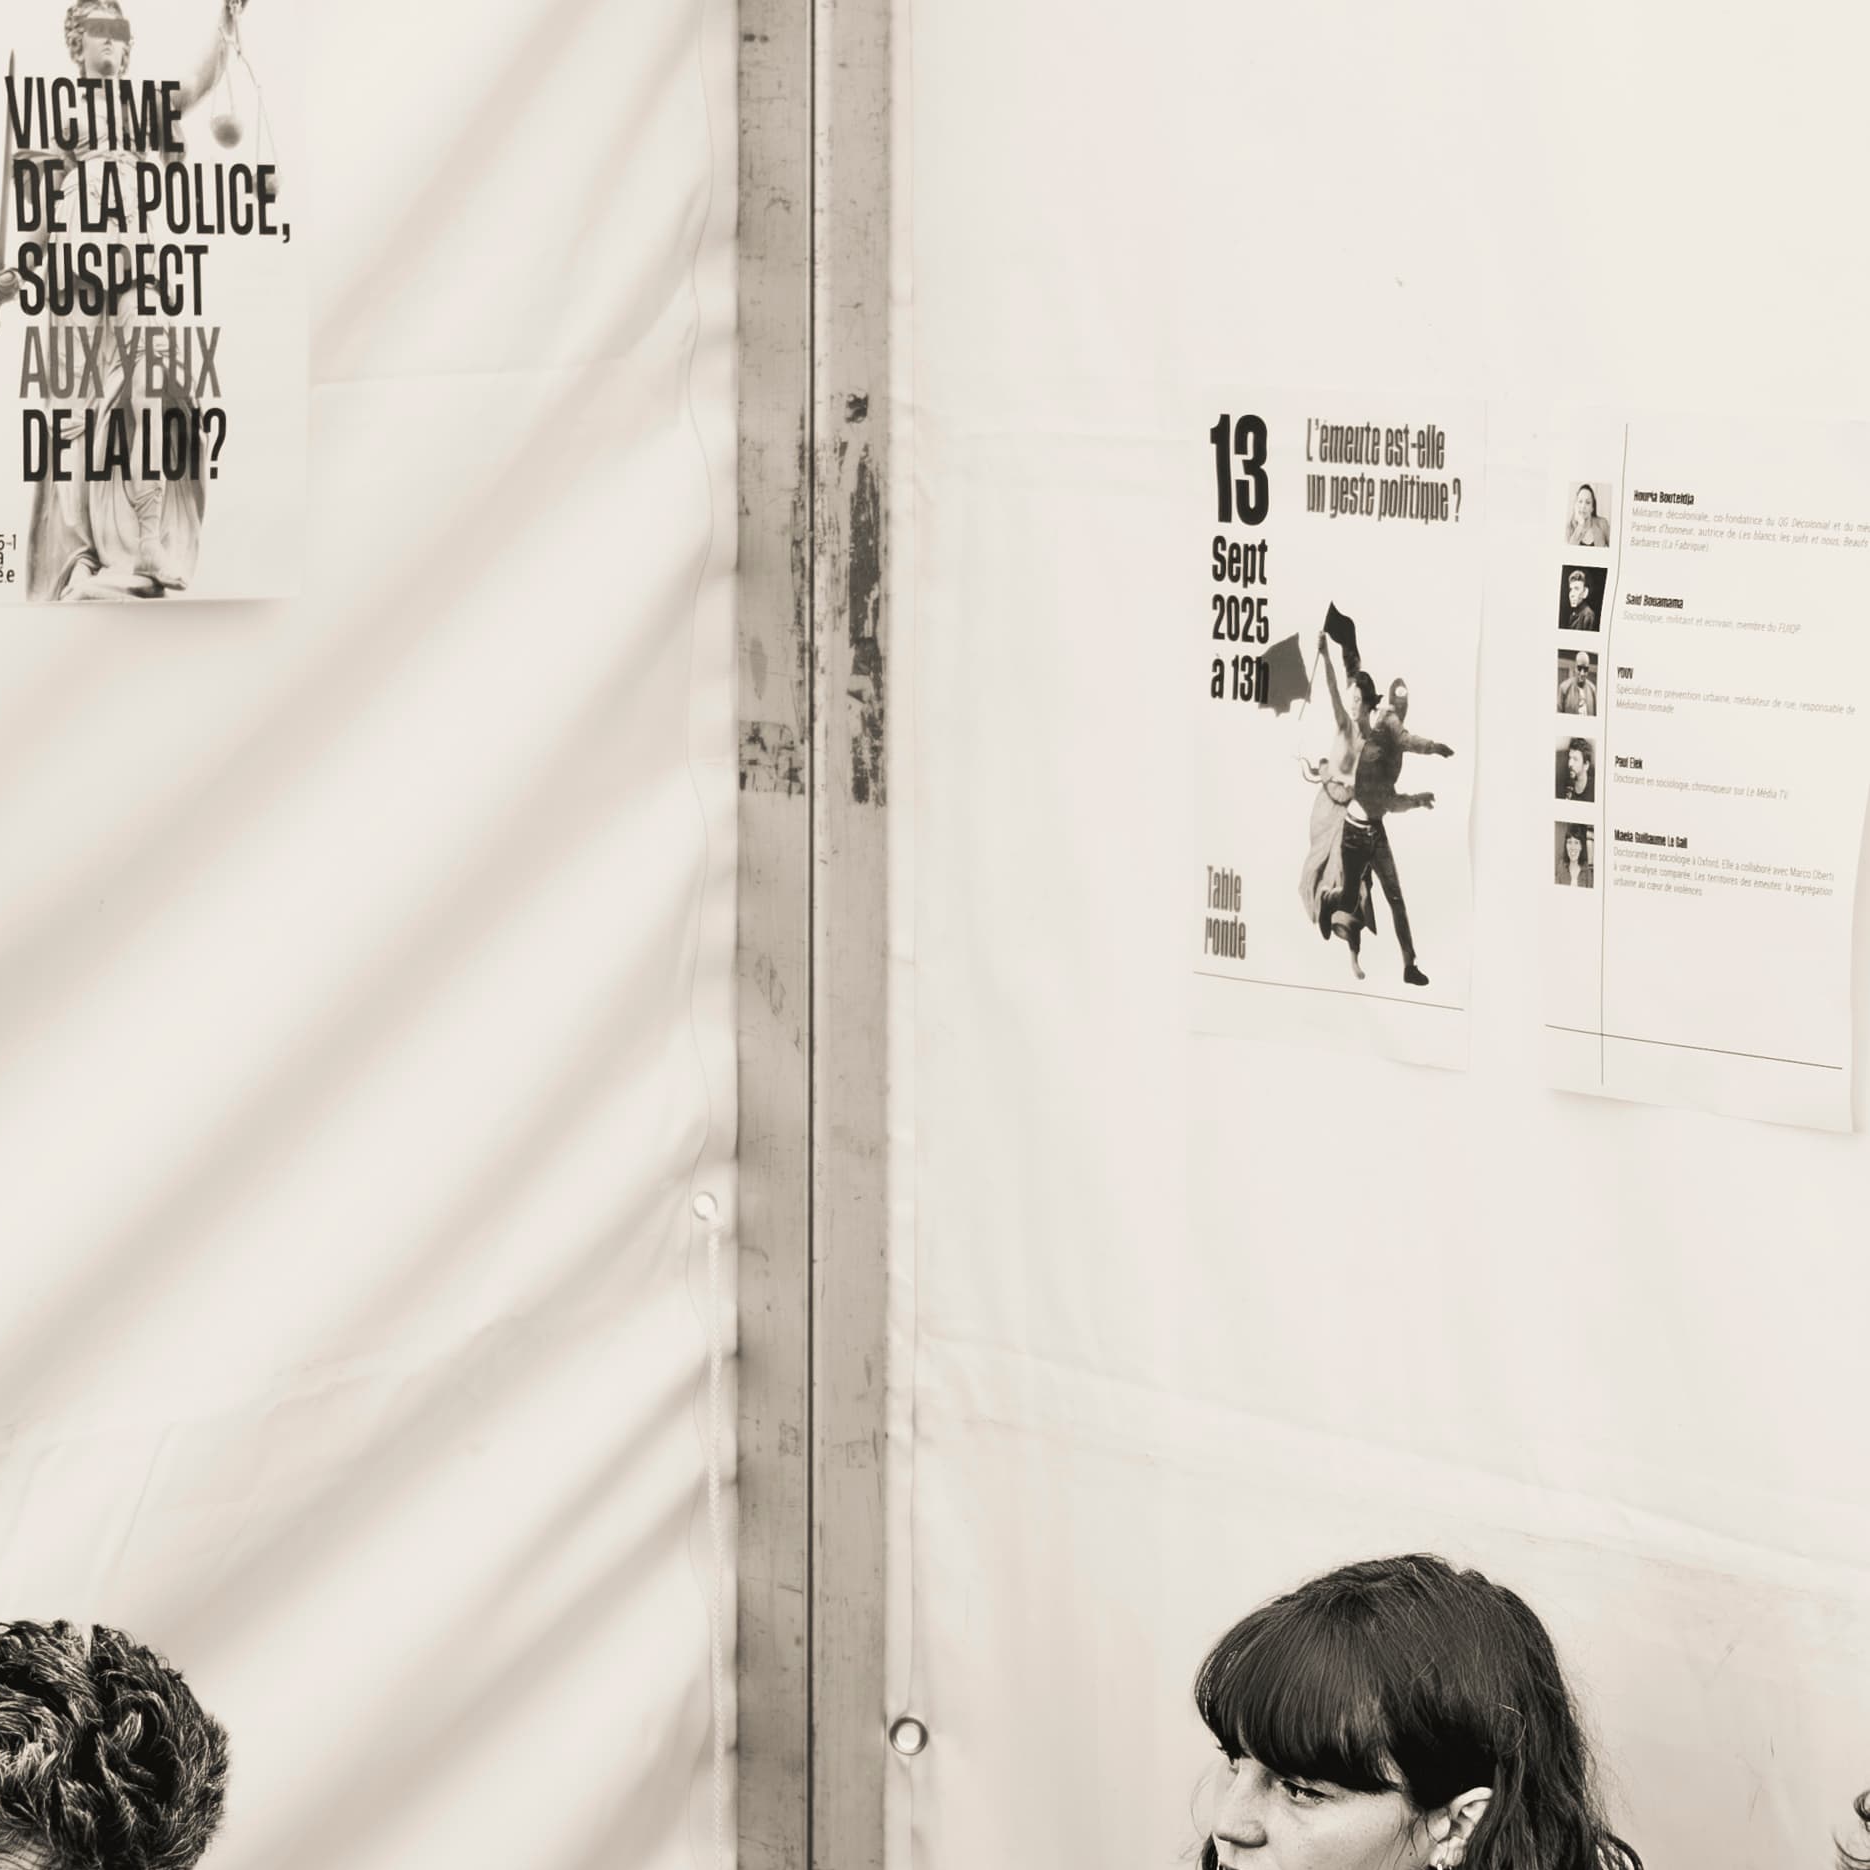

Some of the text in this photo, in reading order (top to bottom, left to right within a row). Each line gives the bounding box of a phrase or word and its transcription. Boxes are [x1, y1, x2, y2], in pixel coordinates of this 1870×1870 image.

[4, 75, 184, 153] VICTIME
[14, 159, 290, 242] DE LA POLICE,
[18, 244, 208, 316] SUSPECT
[19, 326, 220, 399] AUX YEUX
[22, 410, 226, 482] DE LA LOI?
[1210, 413, 1270, 526] 13
[1306, 416, 1446, 471] L'émeute est-elle
[1306, 472, 1326, 512] un
[1329, 480, 1375, 520] geste
[1377, 477, 1449, 525] politique
[1211, 536, 1269, 588] Sept
[1211, 594, 1270, 645] 2025
[1210, 652, 1270, 706] à 13h
[1206, 864, 1242, 913] Table
[1204, 914, 1247, 961] ronde
